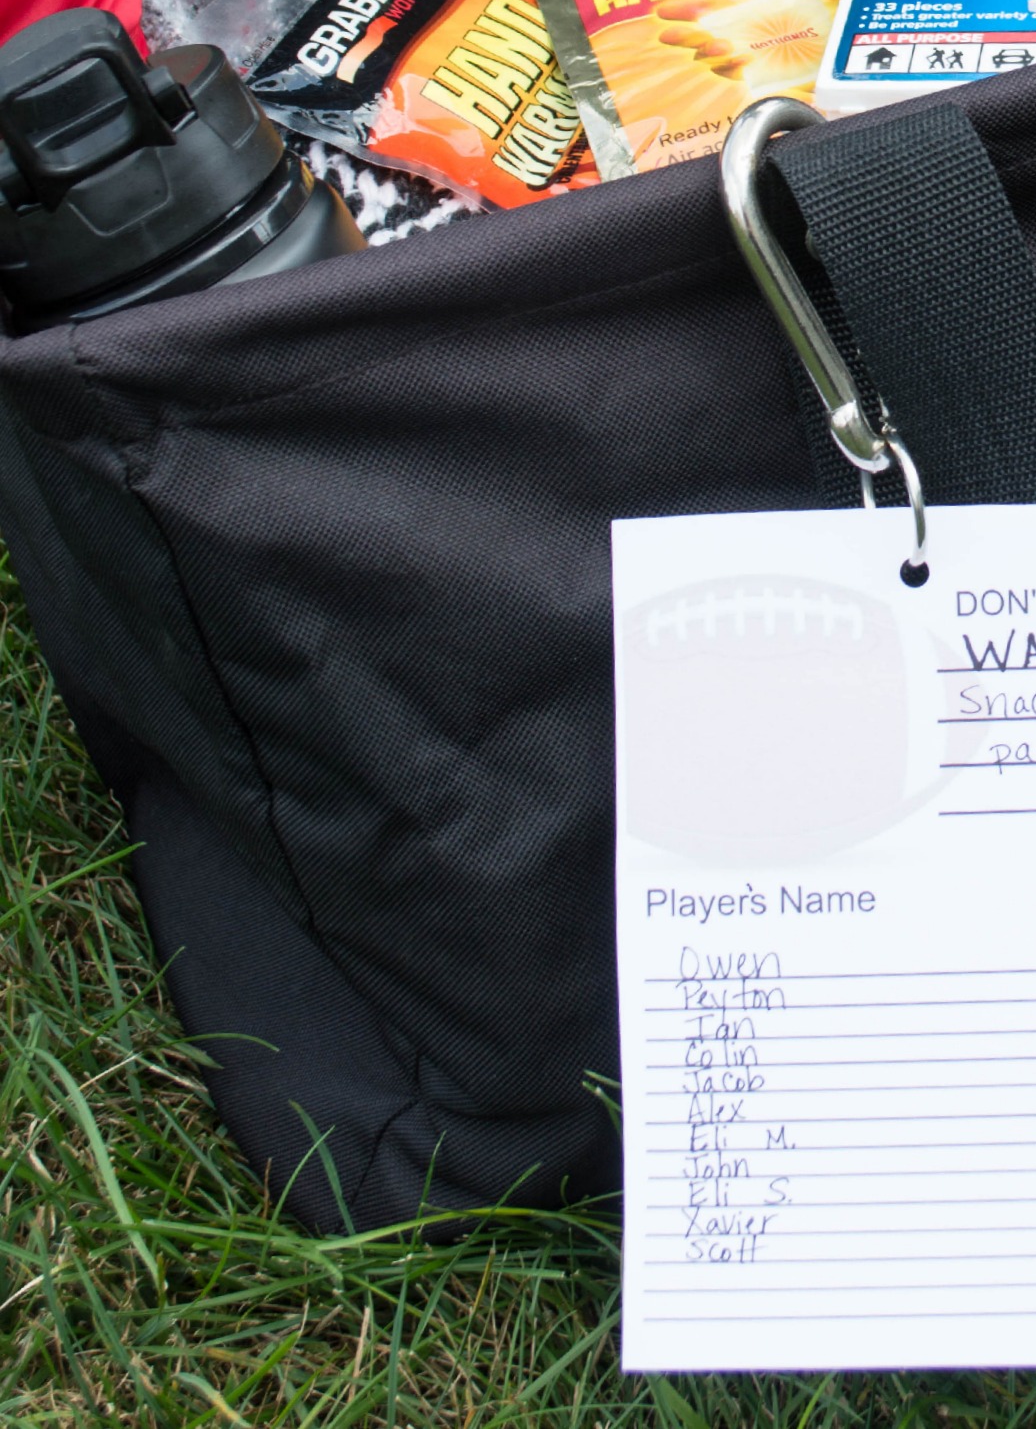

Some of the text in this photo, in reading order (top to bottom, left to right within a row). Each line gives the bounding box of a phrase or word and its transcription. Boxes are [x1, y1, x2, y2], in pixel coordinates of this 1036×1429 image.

[871, 12, 915, 22] Treats
[917, 11, 976, 23] greater
[977, 11, 1028, 23] variety
[873, 1, 964, 15] 33 pieces
[855, 32, 984, 45] ALL PURPOSE
[867, 19, 959, 32] Be prepared
[491, 64, 580, 188] WARM
[659, 119, 721, 148] Ready
[646, 882, 877, 925] Player's Name
[679, 945, 782, 980] Owen
[675, 978, 787, 1018] Peyton
[684, 1013, 756, 1041] Ian
[685, 1040, 759, 1068] Colin
[683, 1067, 765, 1095] Jacob
[687, 1092, 747, 1125] Alex
[688, 1123, 796, 1152] Eli M.
[682, 1150, 751, 1179] John
[688, 1177, 729, 1207] Eli
[681, 1204, 779, 1239] Xavier
[685, 1234, 767, 1264] Scott
